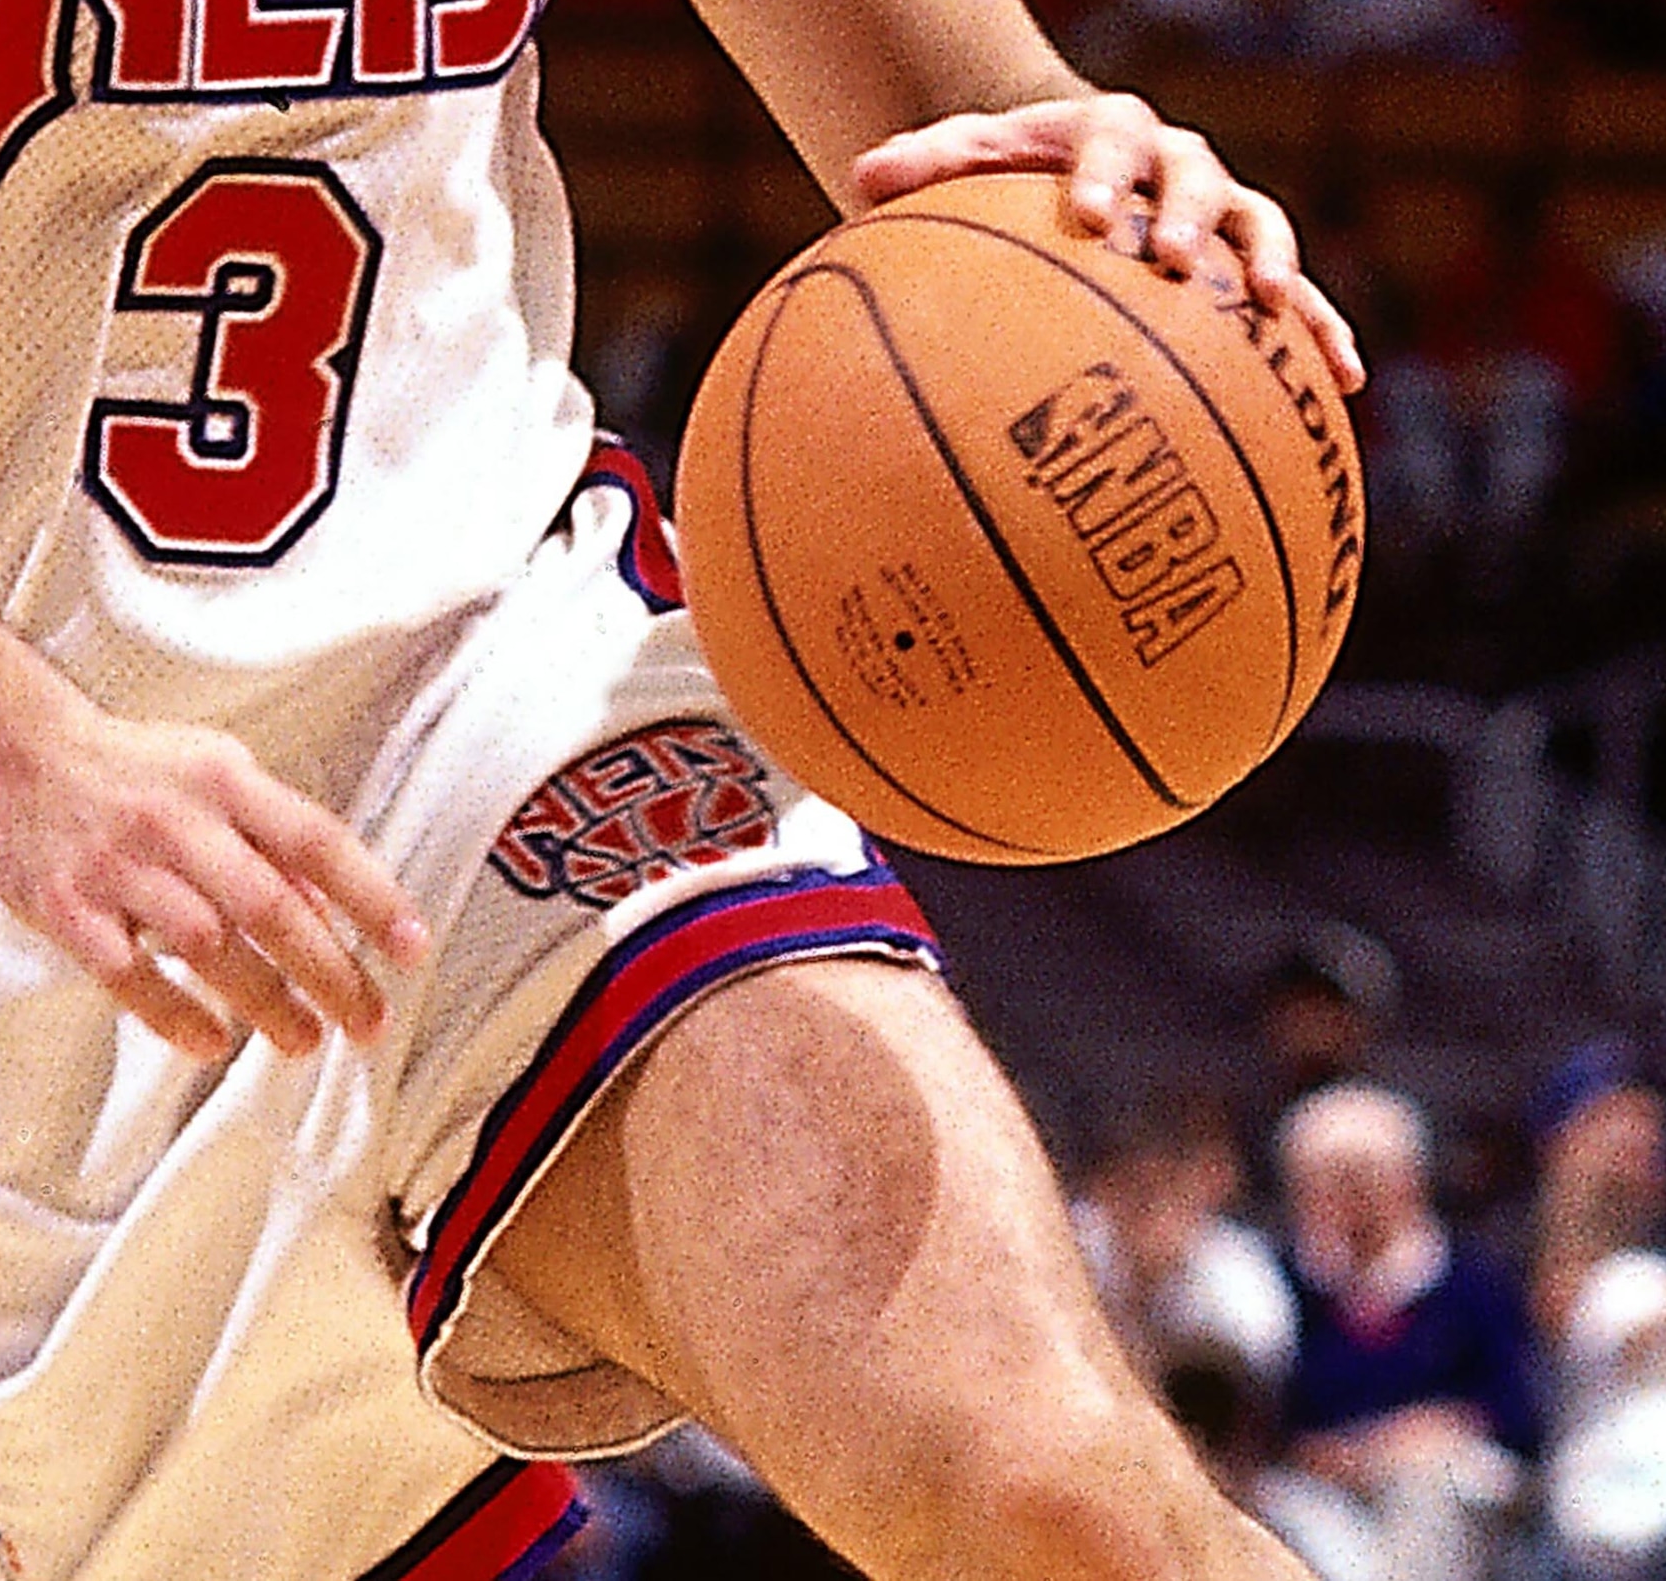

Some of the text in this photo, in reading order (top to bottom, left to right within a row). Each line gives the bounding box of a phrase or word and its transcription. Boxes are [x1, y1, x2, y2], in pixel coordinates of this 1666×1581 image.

[83, 156, 383, 567] 3
[1103, 213, 1361, 640] ALDING
[1052, 415, 1245, 670] NBA
[487, 719, 767, 899] NETS
